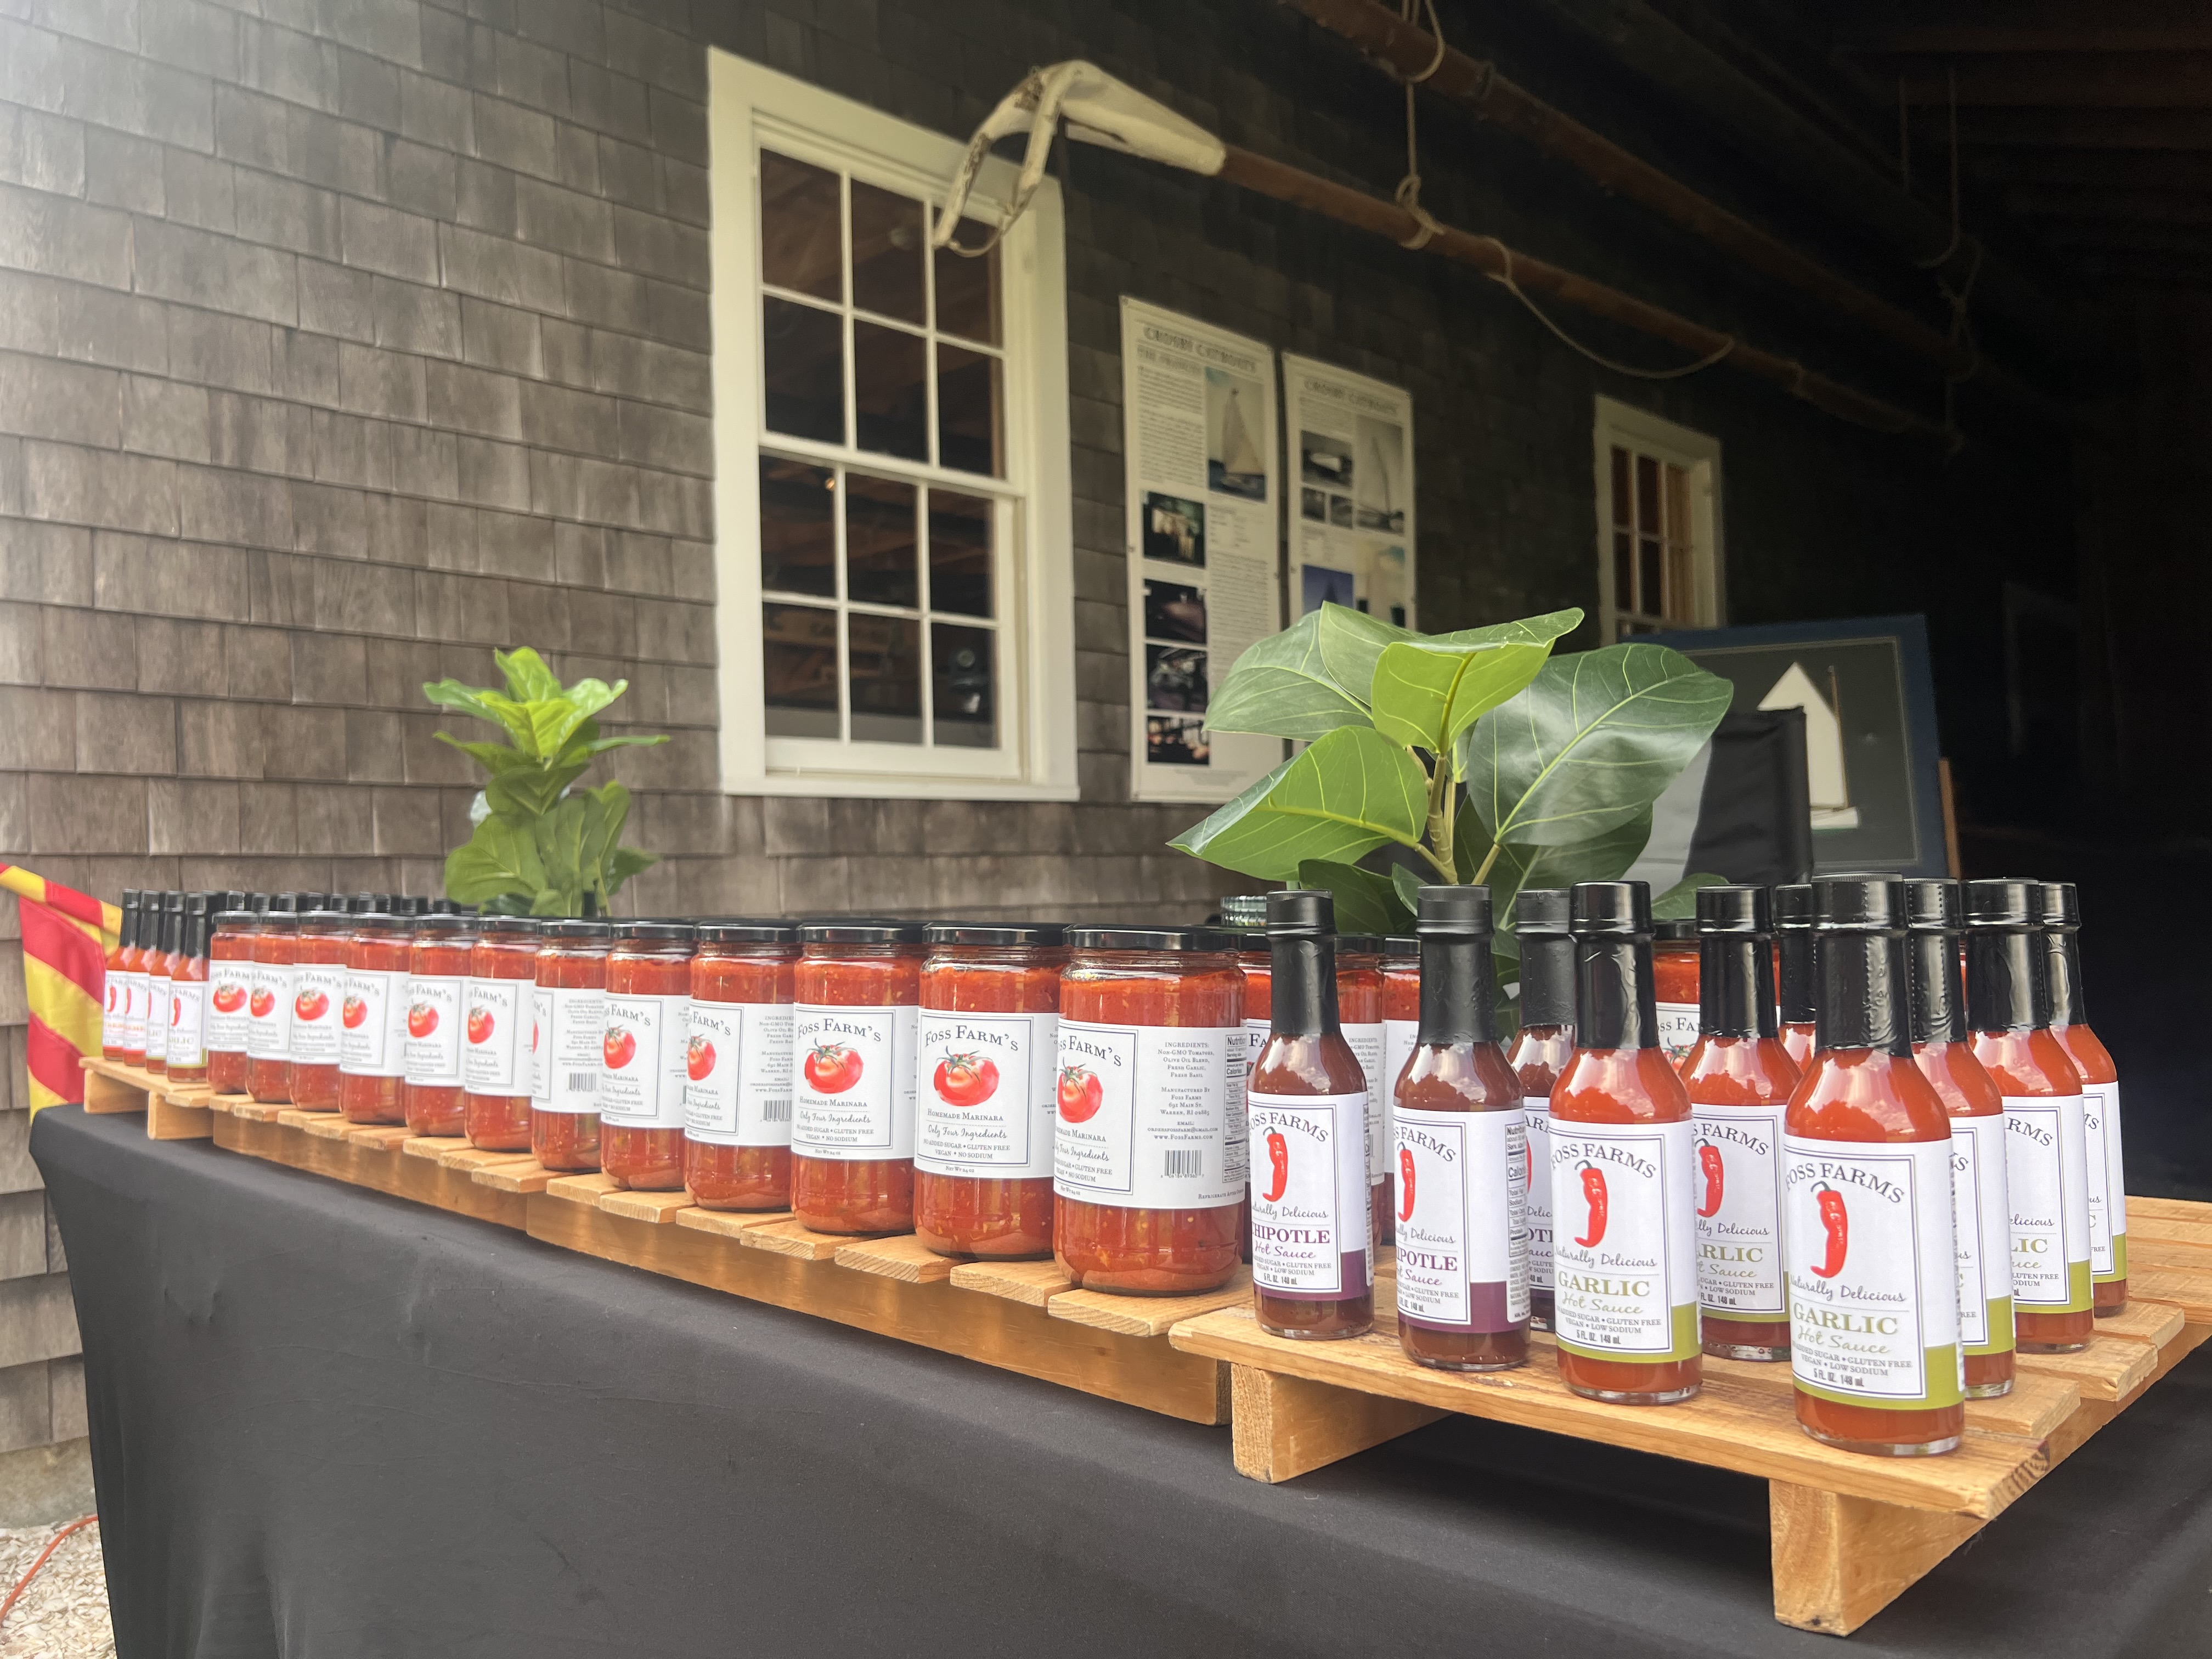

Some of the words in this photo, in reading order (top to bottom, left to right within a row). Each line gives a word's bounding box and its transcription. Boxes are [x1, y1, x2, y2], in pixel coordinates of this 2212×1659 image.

[474, 986, 507, 1007] FARM'S
[612, 1004, 651, 1026] FARM'S
[693, 1011, 731, 1036] FARM'S
[798, 1023, 820, 1040] FOSS
[823, 1018, 882, 1042] FARM'S
[925, 1030, 951, 1047] FOSS
[956, 1025, 1018, 1052] FARM'S
[1069, 1035, 1122, 1066] FARM'S
[799, 1096, 828, 1106] HOMEMADE
[800, 1111, 811, 1121] Only
[812, 1112, 827, 1121] Four
[828, 1113, 872, 1125] Ingredients
[927, 1108, 960, 1119] HOMEMADE
[962, 1112, 1004, 1121] MARINARA
[928, 1125, 941, 1137] Only
[943, 1126, 959, 1137] Four
[961, 1127, 1008, 1140] Ingredients
[1071, 1129, 1107, 1142] MARINARA
[1269, 1112, 1329, 1142] FARMS
[2006, 1117, 2053, 1147] RMS
[1400, 1126, 1457, 1162] FARMS
[1701, 1123, 1769, 1155] FARMS
[1070, 1146, 1110, 1161] Ingredients
[1550, 1143, 1579, 1171] FOSS
[1582, 1143, 1656, 1178] FARMS
[1075, 1164, 1095, 1173] GLUTEN
[1075, 1173, 1096, 1182] SODIUM
[1785, 1163, 1815, 1192] FOSS
[1819, 1163, 1905, 1204] FARMS
[1198, 1191, 1226, 1199] REFRIGERATE
[1252, 1201, 1278, 1221] aturally
[1282, 1206, 1329, 1218] Delicious
[1527, 1206, 1552, 1217] Delic
[2009, 1214, 2055, 1226] elicious
[1410, 1227, 1456, 1244] Delicious
[1718, 1222, 1770, 1235] Delicious
[1255, 1240, 1271, 1255] Hot
[1273, 1245, 1316, 1259] Sauce
[1396, 1245, 1458, 1271] IPOTLE
[1555, 1245, 1594, 1268] Naturally
[1601, 1252, 1658, 1267] Delicious
[1699, 1243, 1763, 1262] RLIC
[1264, 1258, 1282, 1267] SUGAR
[1710, 1263, 1757, 1278] Sauce
[1405, 1268, 1443, 1285] Sauce
[1559, 1271, 1650, 1296] GARLIC
[1700, 1277, 1718, 1285] UGAR
[1723, 1280, 1753, 1289] GLUTEN
[1414, 1287, 1439, 1297] GLUTEN
[1790, 1273, 1833, 1301] Naturally
[1841, 1284, 1906, 1302] Delicious
[1415, 1294, 1441, 1304] SODIUM
[1562, 1291, 1587, 1308] Hot
[1589, 1299, 1644, 1314] Sauce
[1718, 1295, 1728, 1304] 148
[1565, 1317, 1584, 1328] VEGAN
[1609, 1325, 1641, 1334] SODIUM
[1577, 1312, 1600, 1323] SUGAR
[1793, 1302, 1898, 1335] GARLIC
[1576, 1329, 1580, 1338] 5
[1600, 1334, 1611, 1344] 148
[1798, 1325, 1824, 1345] Hot
[1829, 1335, 1890, 1354] Sauce
[1801, 1353, 1821, 1365] VEGAN
[1830, 1362, 1848, 1372] LOW
[1850, 1366, 1888, 1376] SODIUM
[1814, 1349, 1840, 1362] SUGAR
[1847, 1356, 1886, 1368] GLUTEN
[1814, 1368, 1818, 1378] 5
[1841, 1374, 1853, 1385] 148
